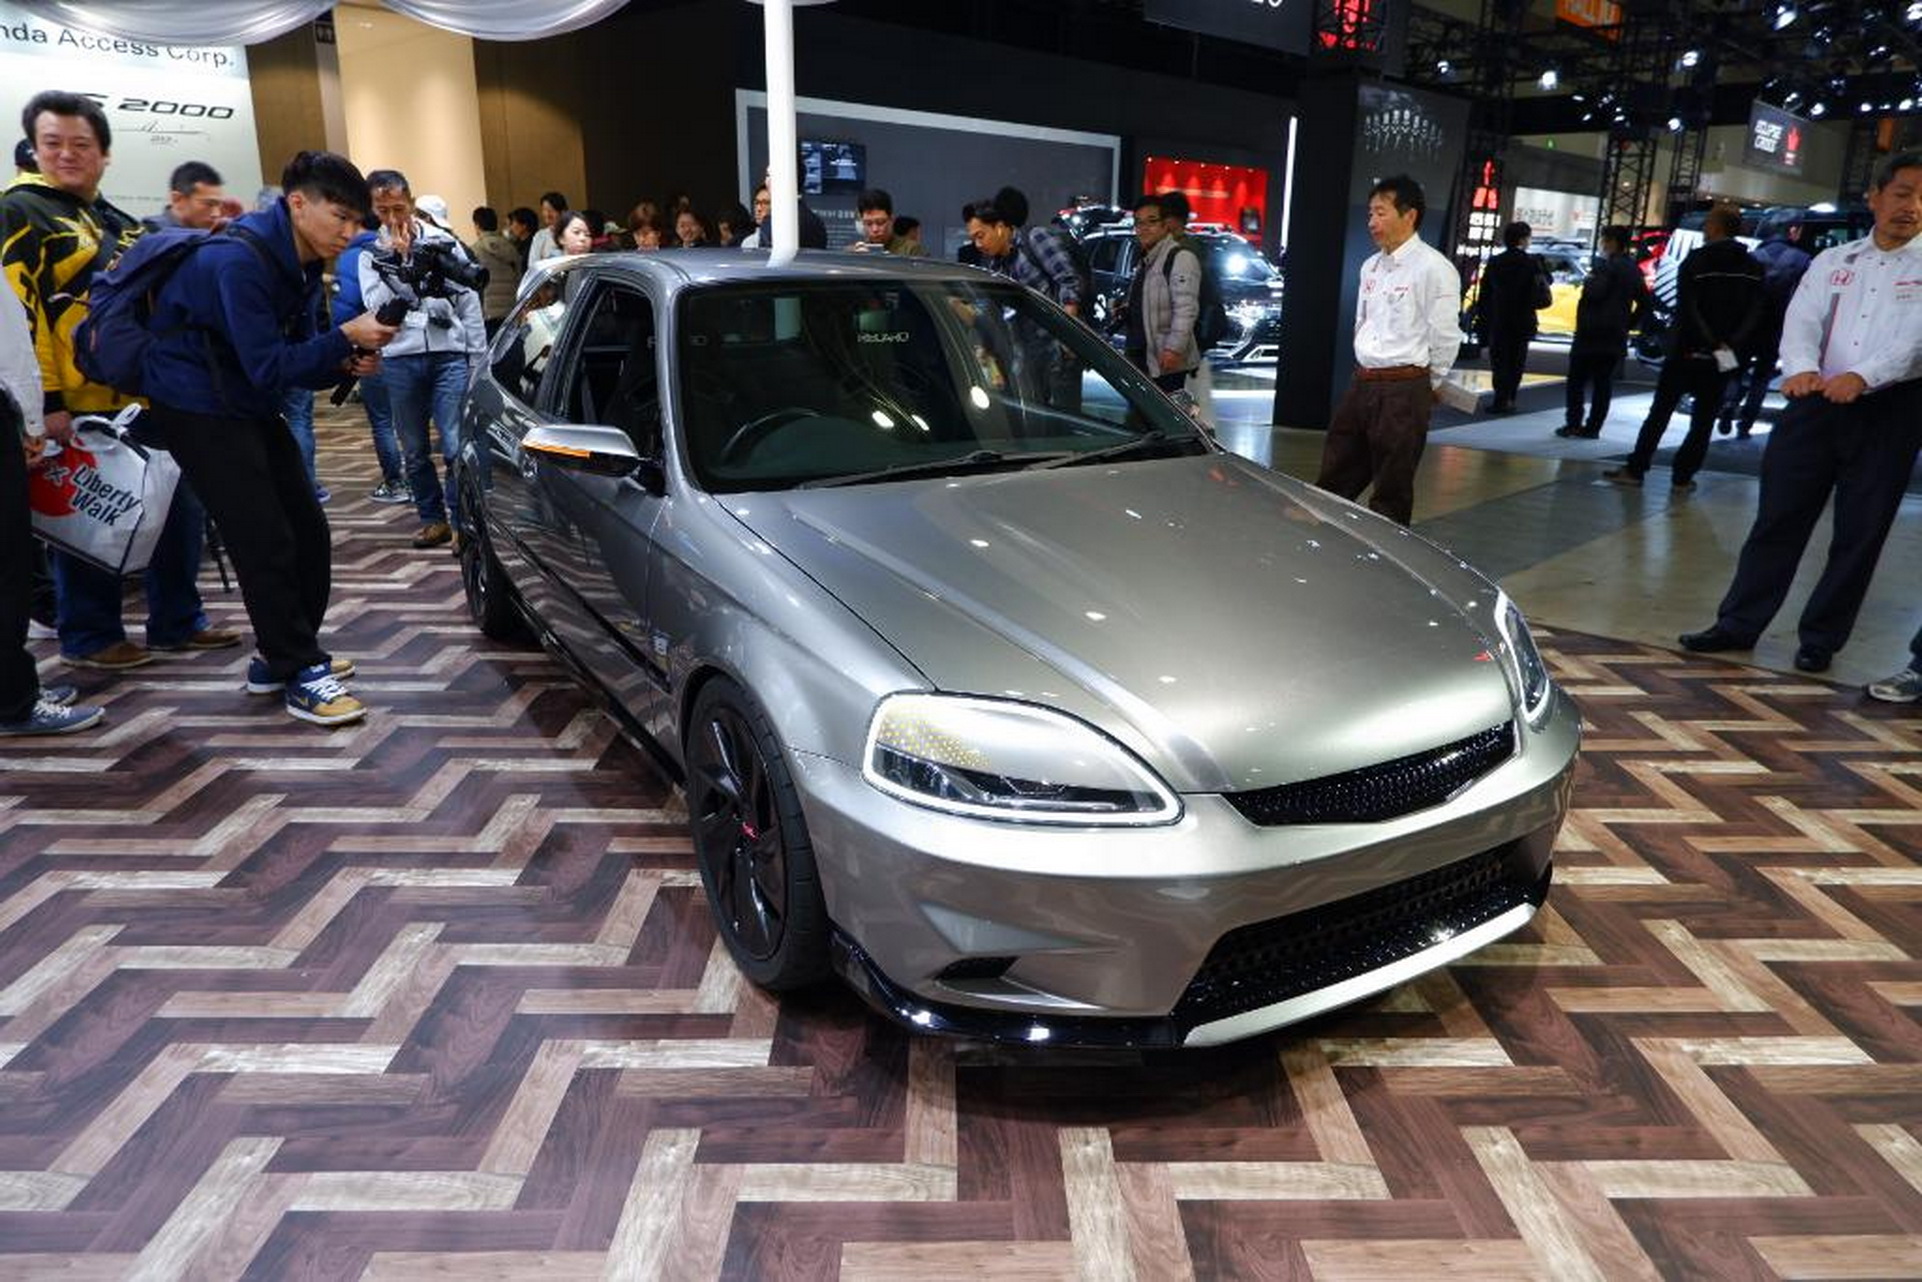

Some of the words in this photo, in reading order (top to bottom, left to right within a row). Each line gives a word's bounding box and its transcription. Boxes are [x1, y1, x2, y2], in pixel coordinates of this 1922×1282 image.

[58, 28, 159, 57] Access
[166, 46, 234, 68] Corp.
[72, 489, 121, 526] Walk
[73, 466, 141, 513] Liberty
